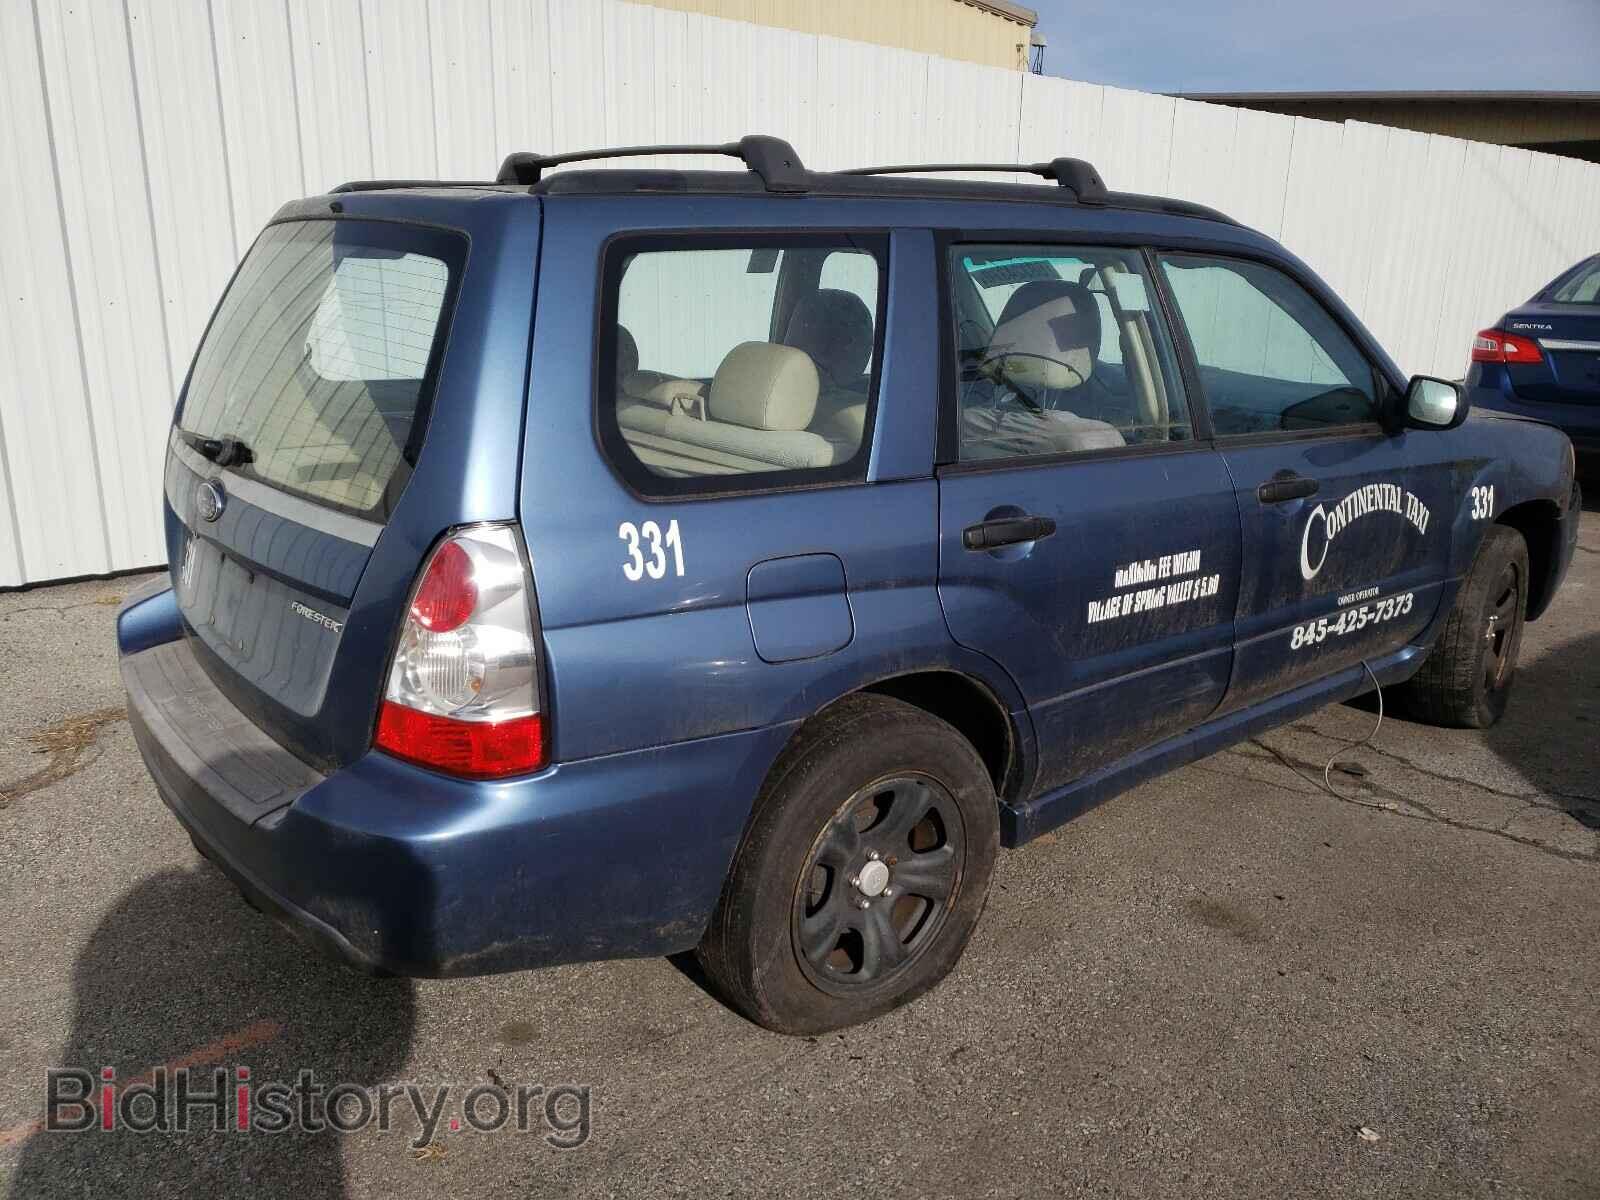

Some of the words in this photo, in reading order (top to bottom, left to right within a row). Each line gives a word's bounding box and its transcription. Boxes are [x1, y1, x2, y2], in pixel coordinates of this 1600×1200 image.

[1513, 323, 1552, 331] SENTRA
[1471, 484, 1494, 520] 331
[618, 519, 685, 581] 331
[1300, 483, 1403, 581] CONTINENTAL
[1406, 491, 1430, 535] TAXI
[1158, 555, 1172, 578] FEE
[1173, 549, 1201, 575] WITHIN
[290, 601, 343, 632] FORESTER
[1088, 595, 1121, 624] VILLAGE
[1121, 592, 1135, 616] OF
[1134, 585, 1166, 613] SPRING
[1167, 579, 1193, 605] VALLEY
[1290, 592, 1414, 650] 845-425-7373
